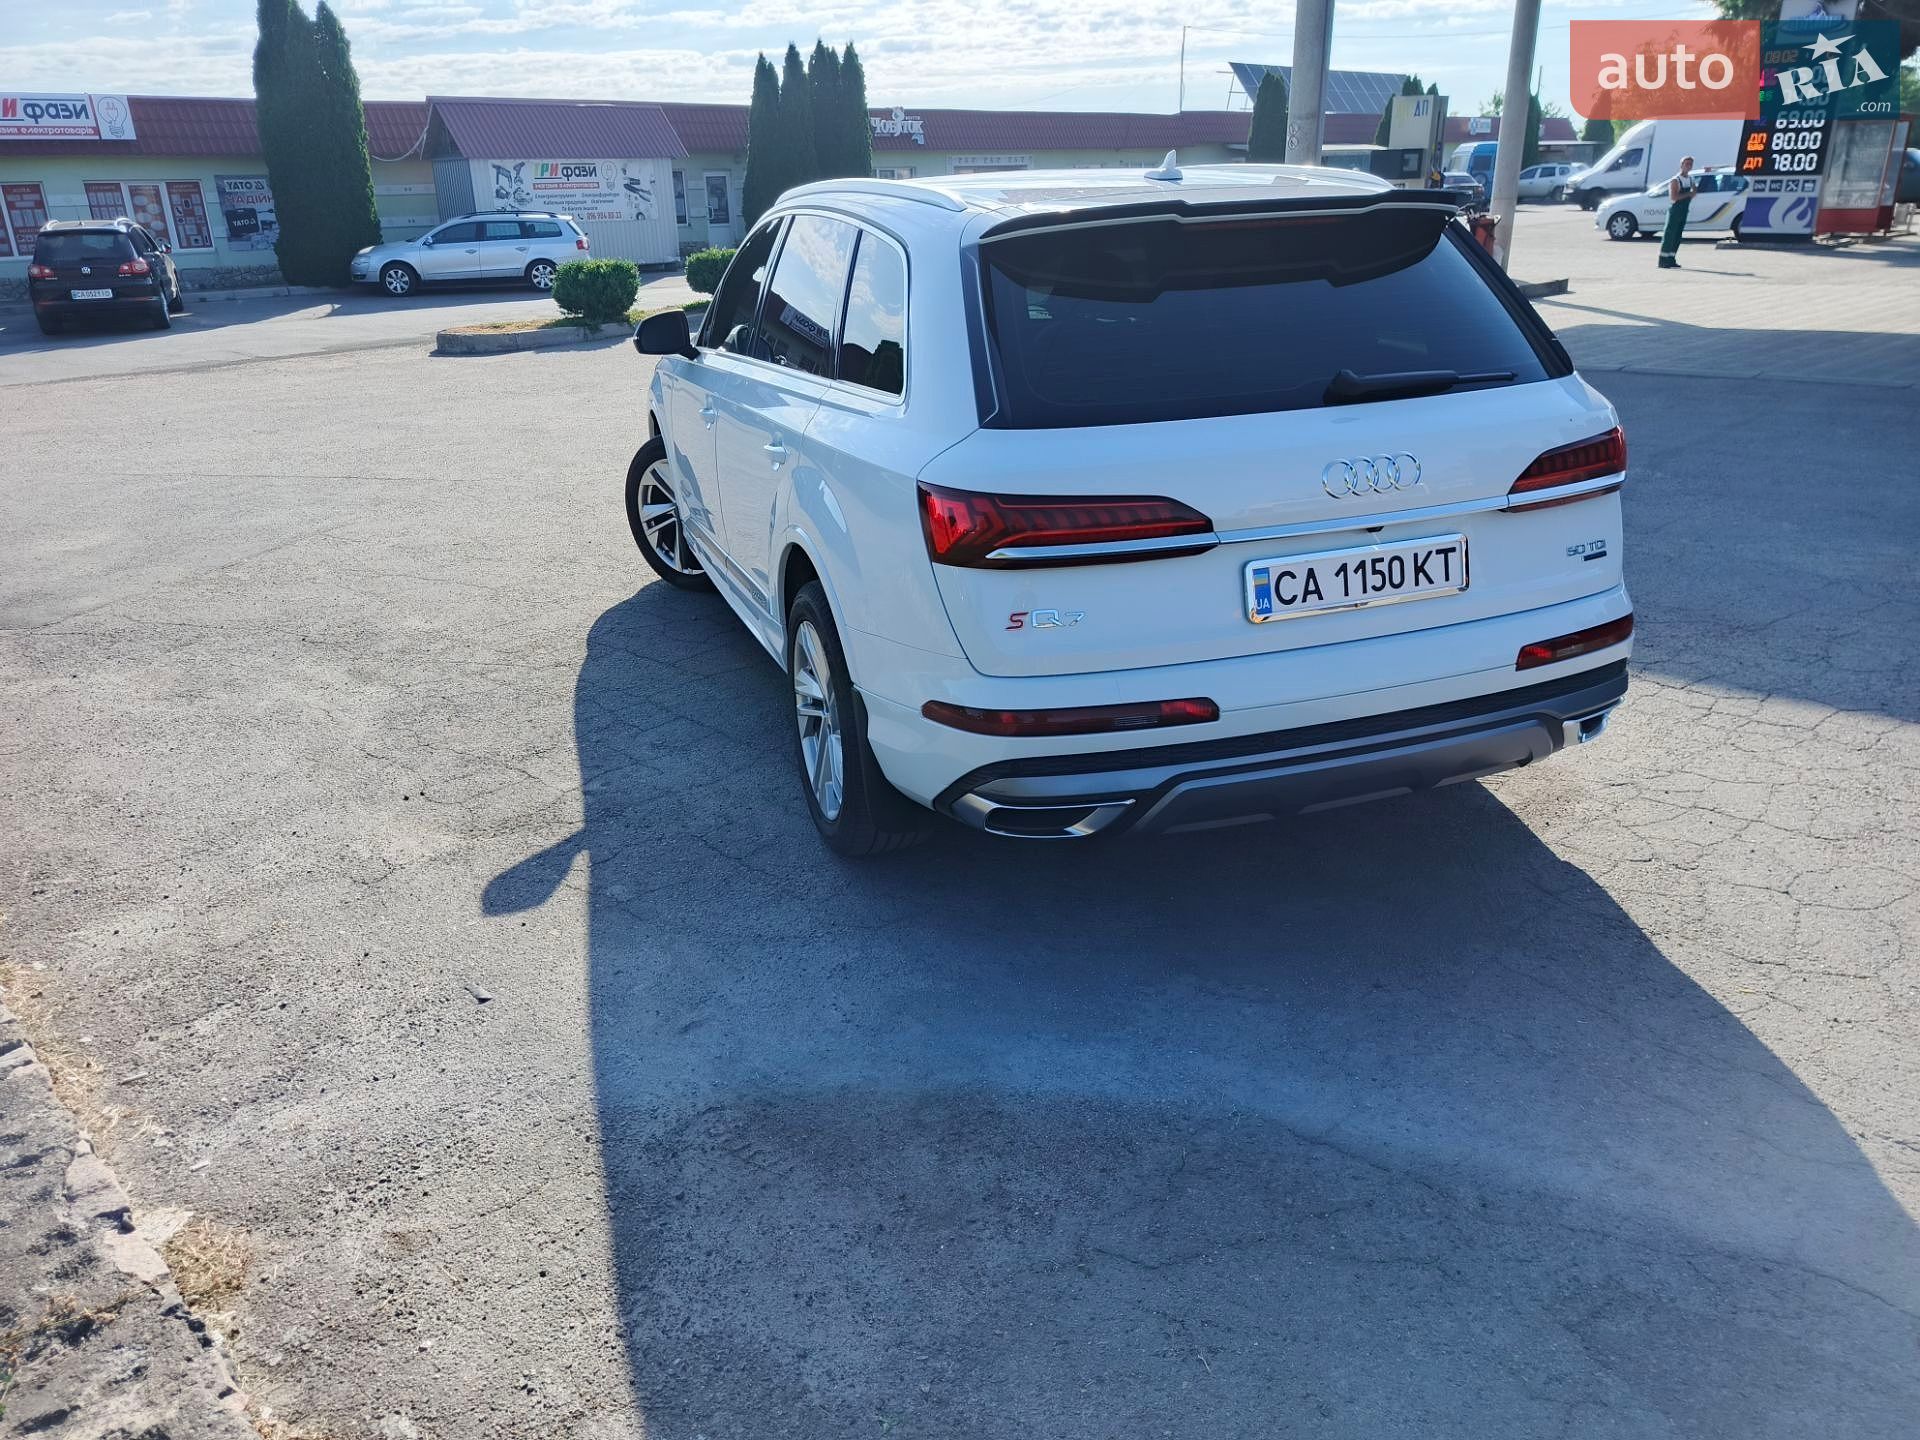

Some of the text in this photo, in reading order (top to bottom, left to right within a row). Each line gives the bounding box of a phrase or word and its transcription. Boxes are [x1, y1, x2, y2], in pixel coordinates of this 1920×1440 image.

[23, 102, 90, 125] фази
[1771, 131, 1822, 151] 80.00
[1743, 153, 1818, 171] ДП 78.00
[532, 163, 597, 182] ТРИ фази
[226, 181, 253, 190] YATO
[233, 218, 249, 227] YATO
[1274, 546, 1457, 606] CA 1150 KT
[1256, 597, 1271, 610] UA
